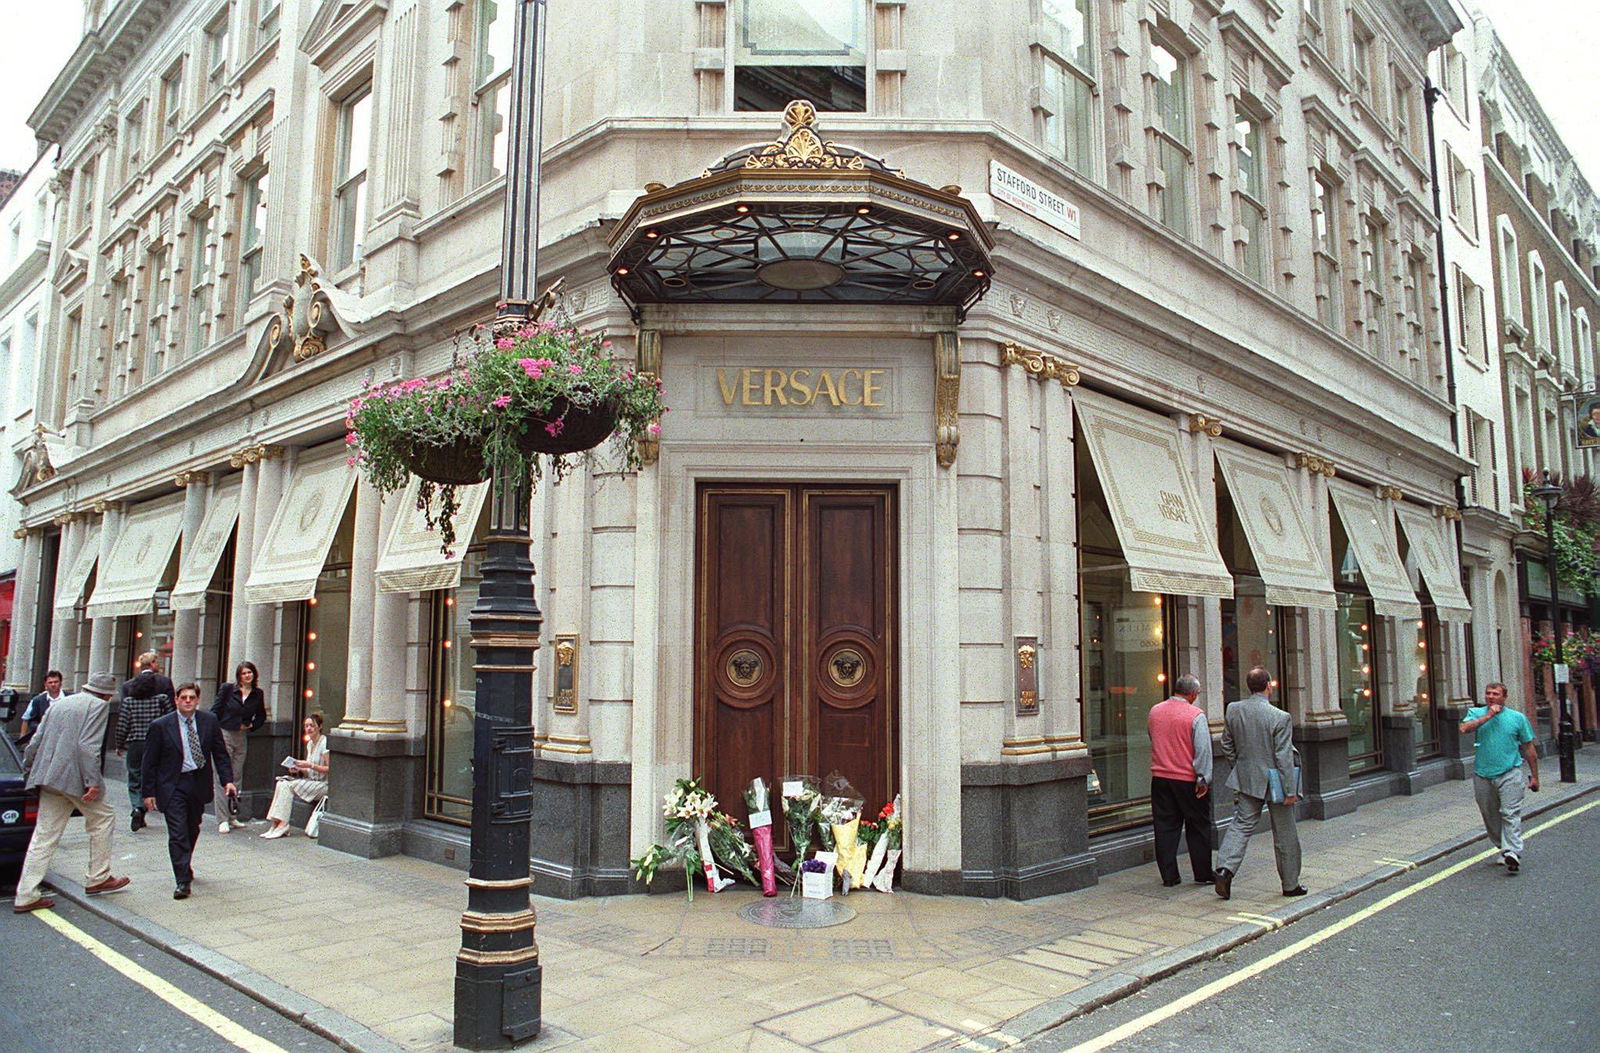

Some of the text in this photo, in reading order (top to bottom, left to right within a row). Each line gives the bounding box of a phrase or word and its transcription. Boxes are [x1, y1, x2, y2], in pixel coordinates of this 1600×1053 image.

[997, 168, 1077, 222] STAFFORD STREET W1
[715, 368, 886, 408] VERSACE
[1158, 503, 1190, 524] VERSACE
[1159, 490, 1185, 509] GIANNI
